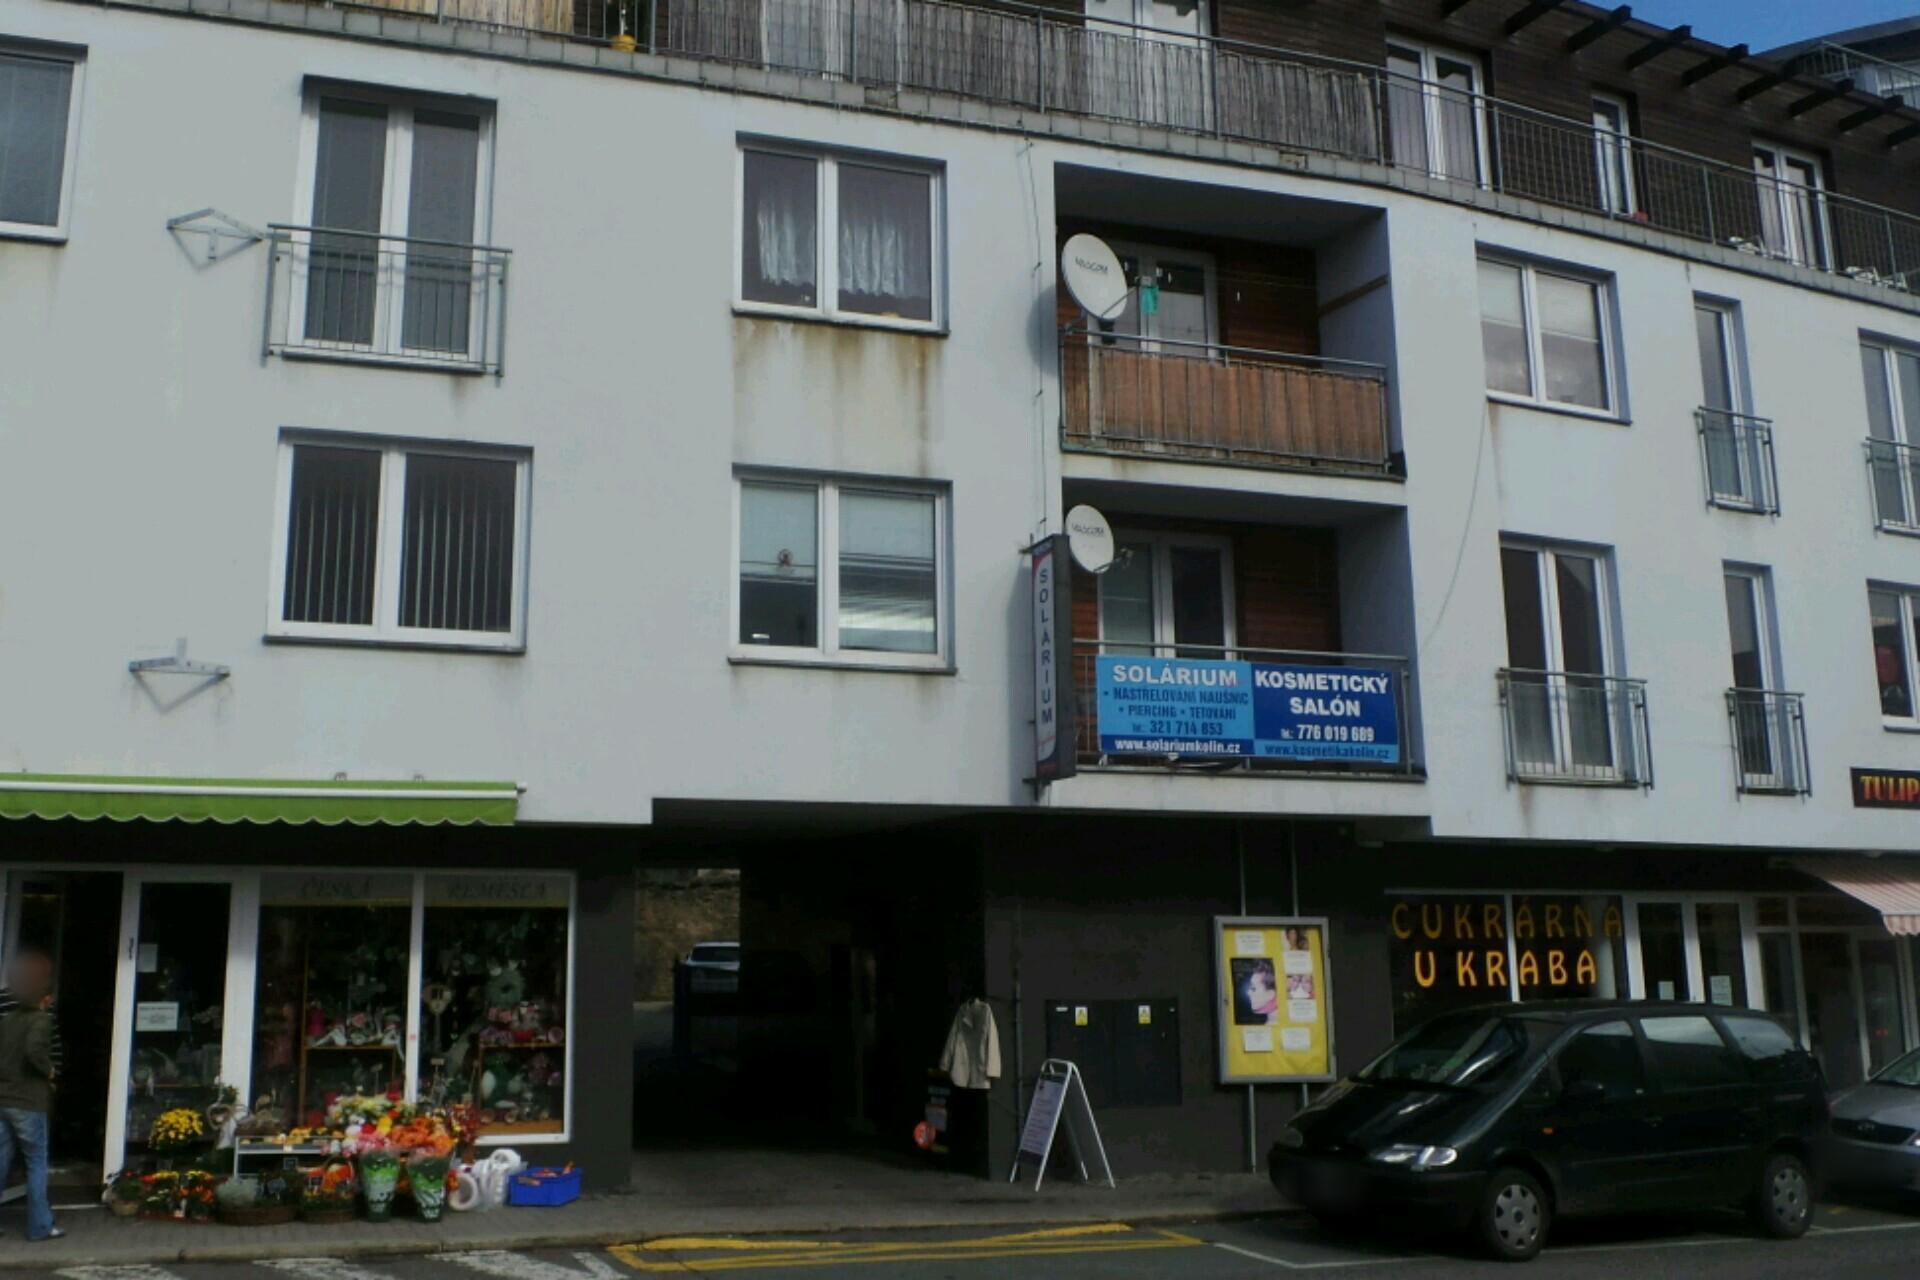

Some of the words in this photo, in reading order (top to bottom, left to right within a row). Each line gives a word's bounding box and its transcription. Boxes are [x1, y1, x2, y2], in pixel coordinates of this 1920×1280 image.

[1112, 663, 1237, 687] SOLÁRIUM
[1255, 670, 1389, 694] KOSMETICKÝ
[1290, 695, 1361, 717] SALÓN
[1150, 721, 1171, 734] 321
[1297, 724, 1321, 740] 776
[1860, 775, 1920, 802] TULIP
[1414, 950, 1437, 988] U
[1456, 949, 1597, 987] KRABA
